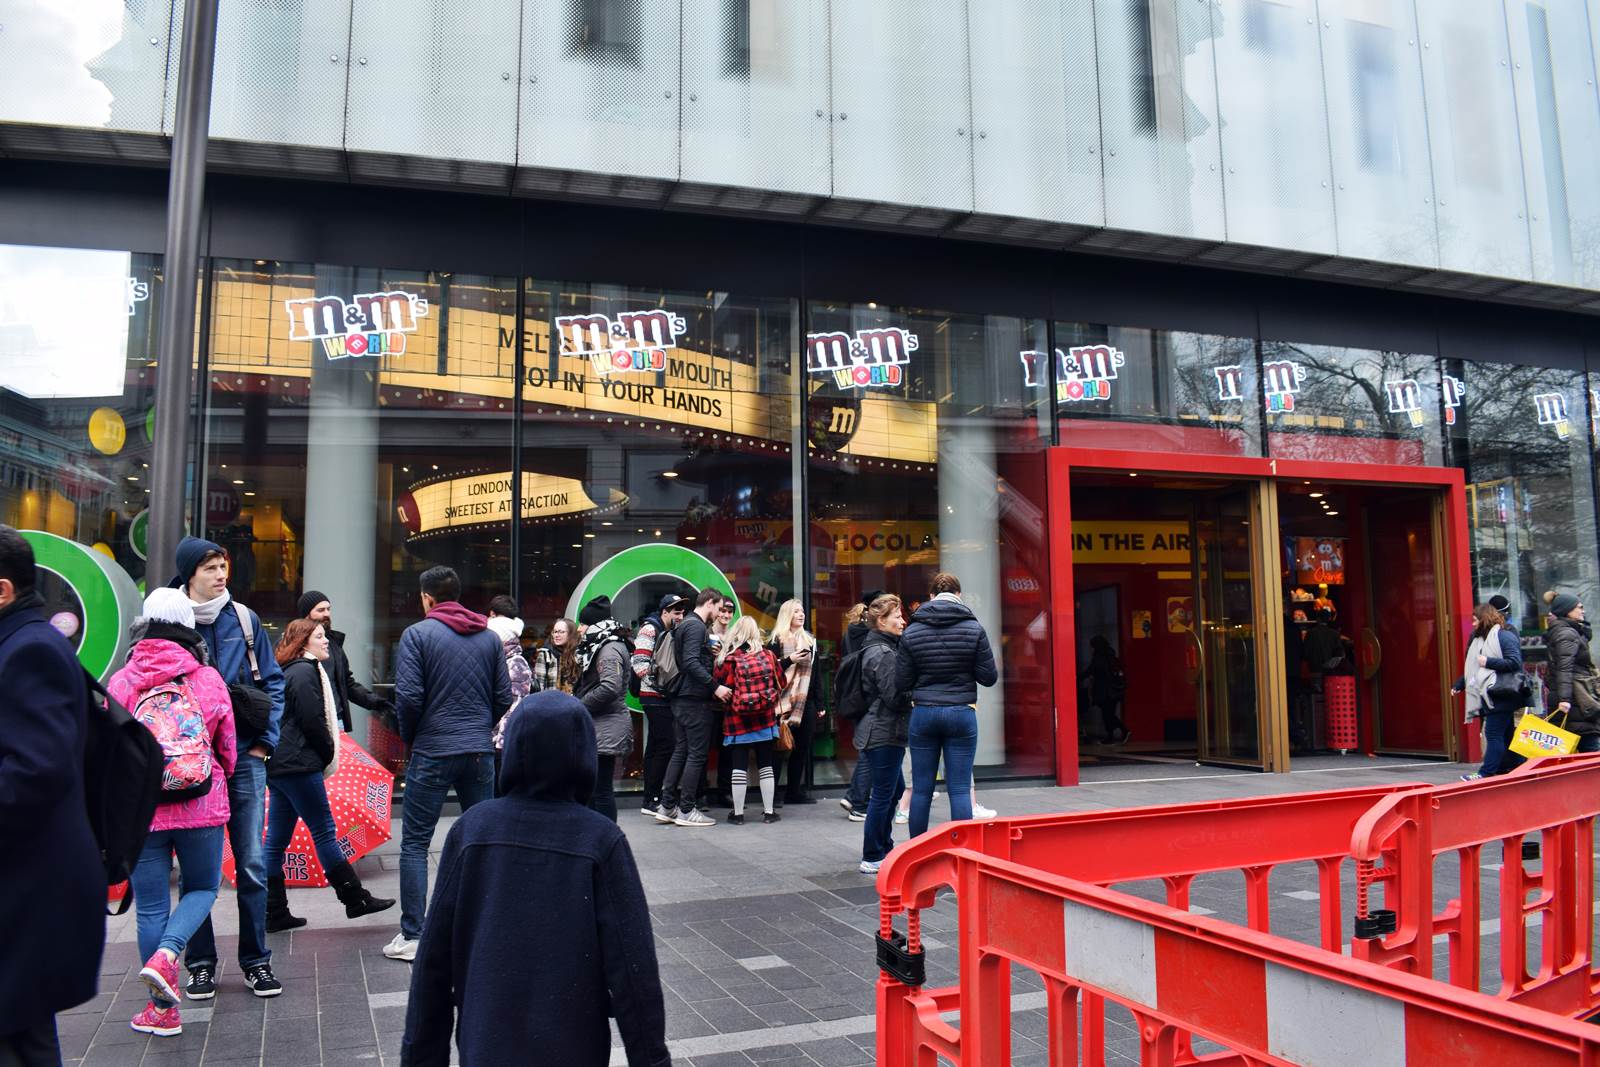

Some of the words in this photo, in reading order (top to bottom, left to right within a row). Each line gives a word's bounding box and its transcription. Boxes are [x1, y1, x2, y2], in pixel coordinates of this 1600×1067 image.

[287, 292, 428, 338] m&m's
[325, 332, 405, 358] WORLD
[557, 311, 685, 353] m&m's
[807, 329, 919, 369] m&m's
[669, 359, 732, 388] MOUTH
[836, 365, 902, 388] WORLD
[564, 371, 584, 393] IN
[600, 377, 655, 405] YOUR
[664, 389, 722, 417] HANDS
[1269, 460, 1277, 475] 1
[445, 502, 495, 519] SWEETEST
[499, 493, 569, 512] ATRACTION
[833, 534, 939, 551] HOCOLA
[1099, 533, 1145, 551] THE
[366, 781, 378, 811] FREE
[376, 782, 389, 820] TOURS
